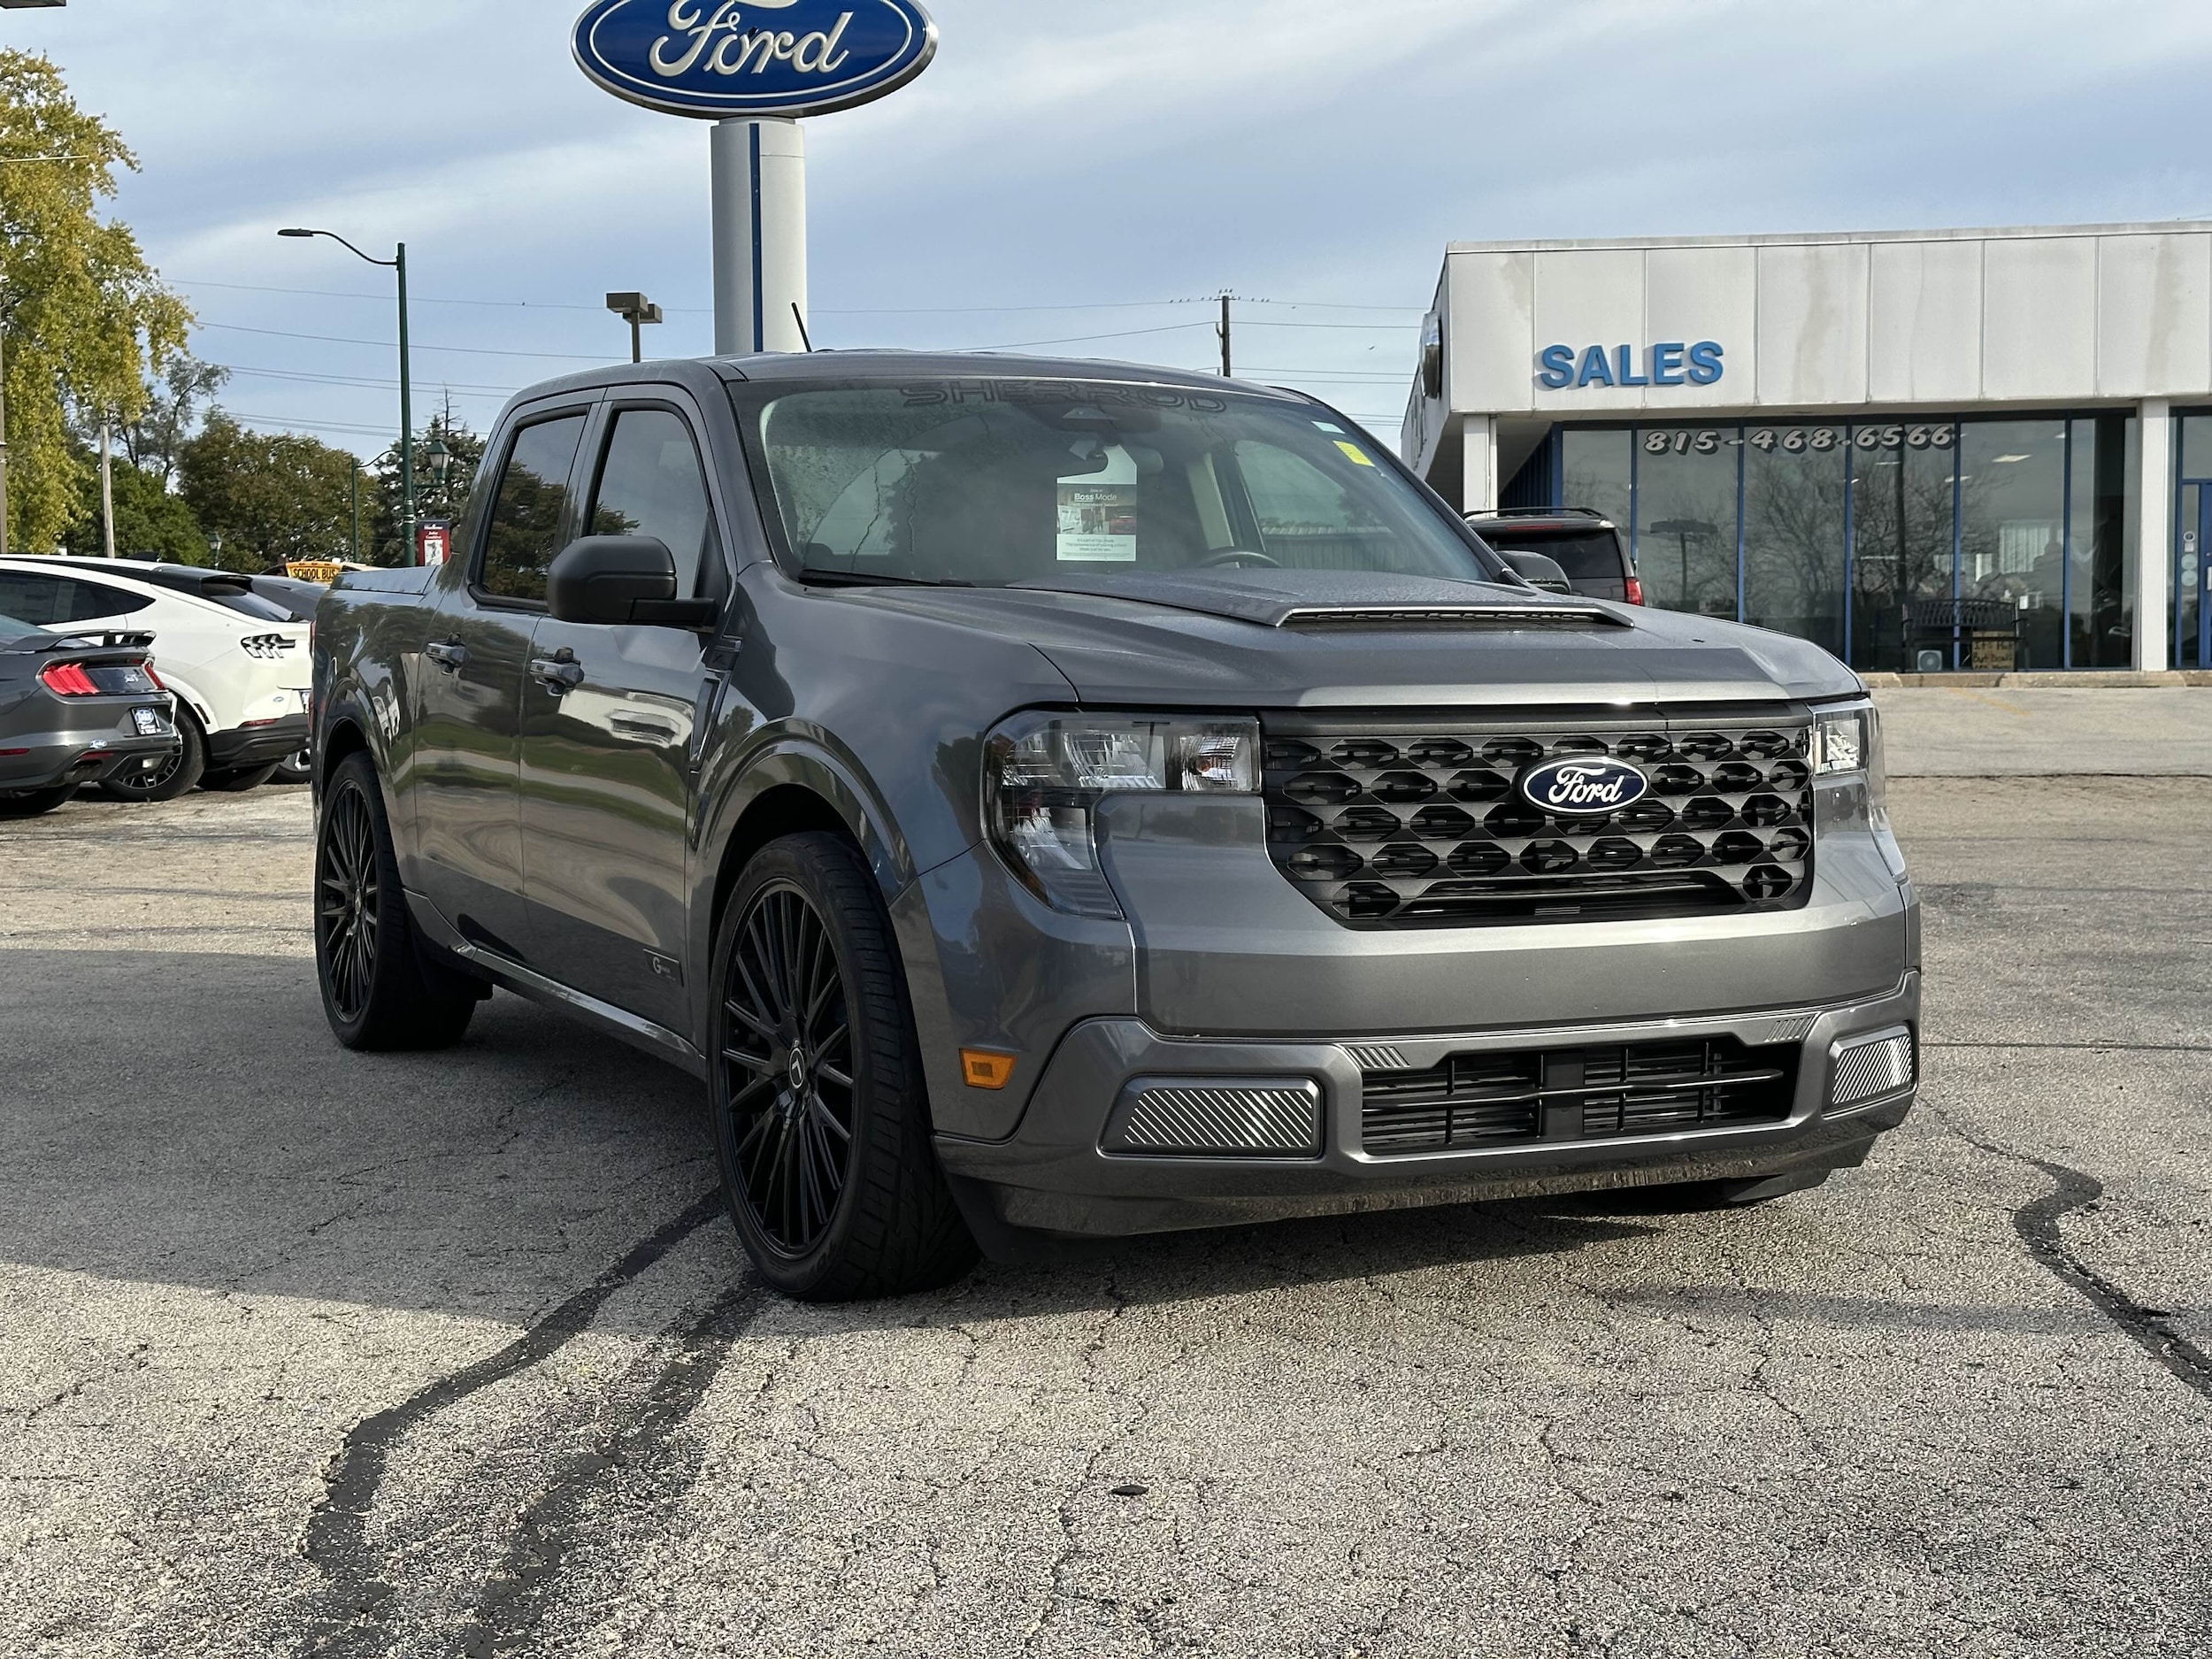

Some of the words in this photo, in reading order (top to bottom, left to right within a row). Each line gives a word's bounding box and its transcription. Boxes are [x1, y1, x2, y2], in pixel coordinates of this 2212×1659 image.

[649, 0, 856, 76] Ford
[1540, 342, 1724, 388] SALES
[900, 380, 1226, 412] SHERROD
[1074, 493, 1094, 502] Boss
[293, 568, 320, 580] SCHOOL
[321, 568, 335, 580] BUS
[1548, 766, 1624, 803] Ford
